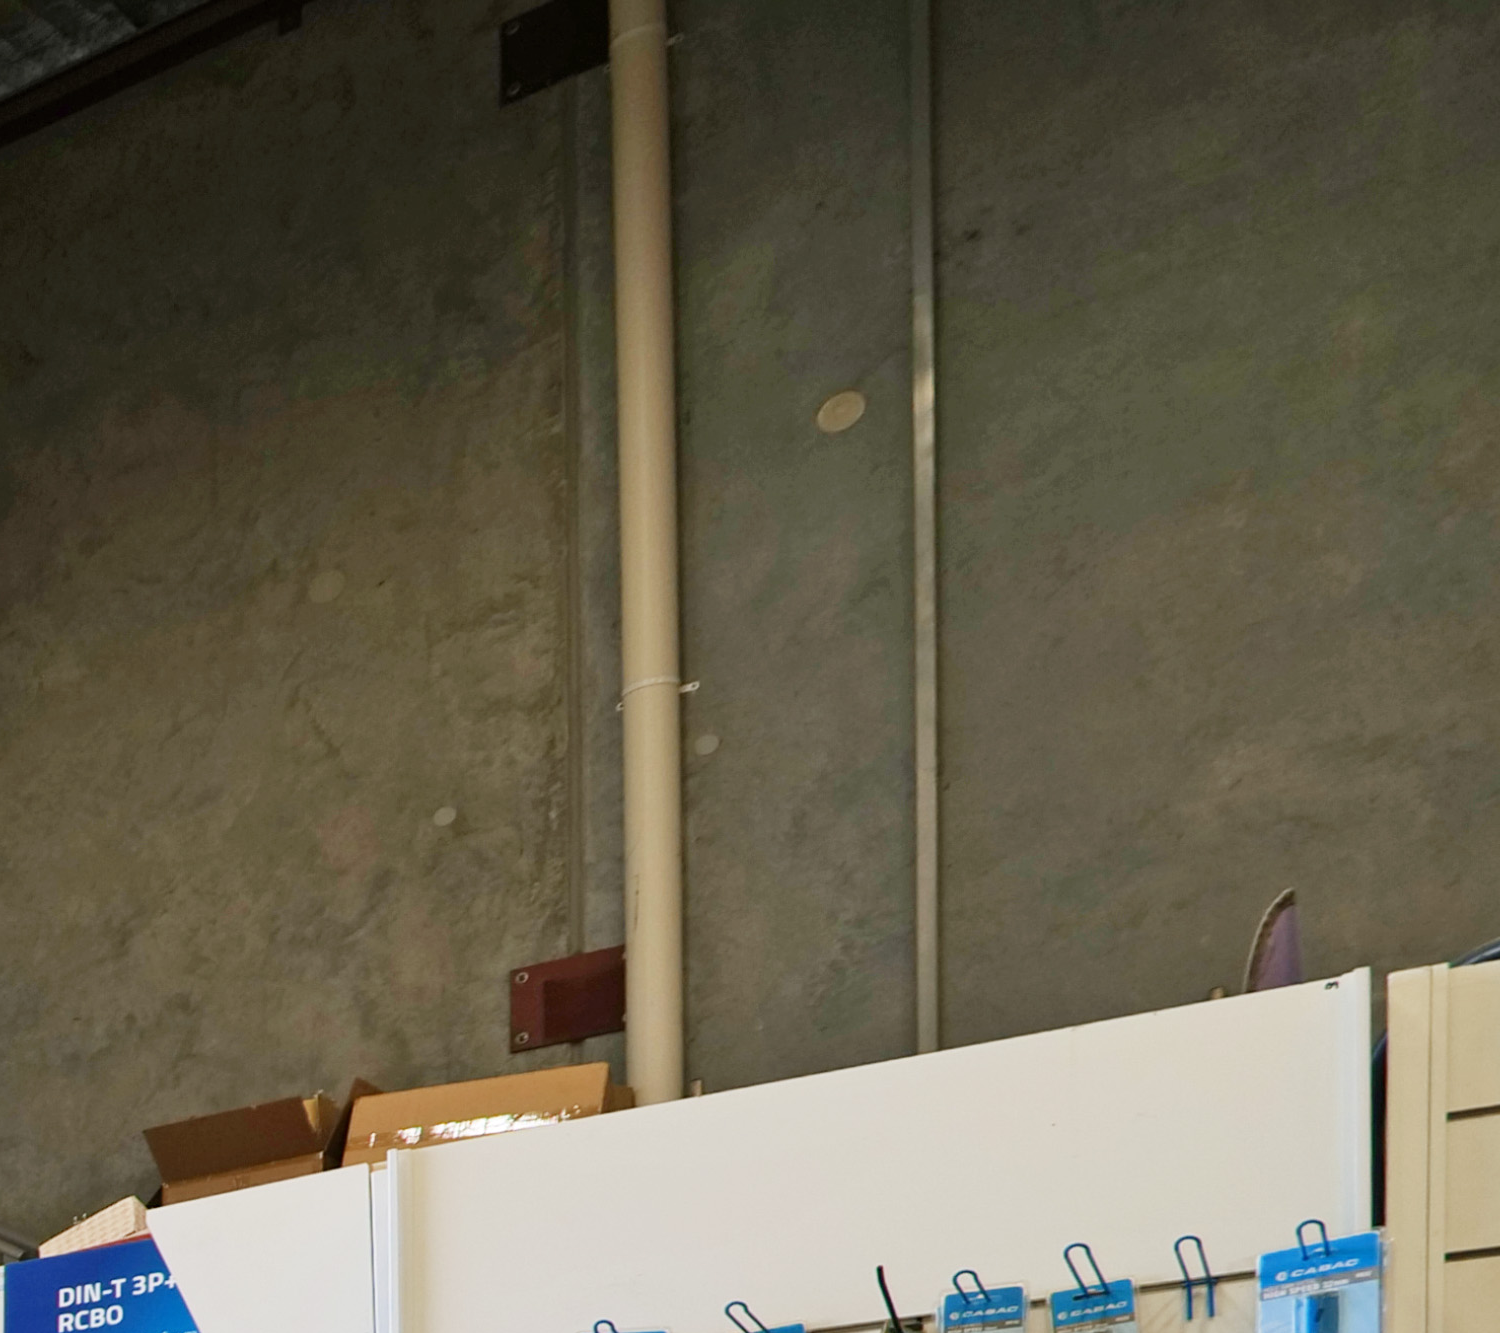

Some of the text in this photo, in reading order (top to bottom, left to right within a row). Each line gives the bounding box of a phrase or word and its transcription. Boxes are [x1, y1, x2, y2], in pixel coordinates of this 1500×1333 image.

[1291, 1258, 1360, 1277] CABAC
[58, 1278, 126, 1309] DIN-T
[962, 1305, 1018, 1319] CABAC
[1070, 1301, 1128, 1317] CABAC
[58, 1305, 123, 1333] RCBO
